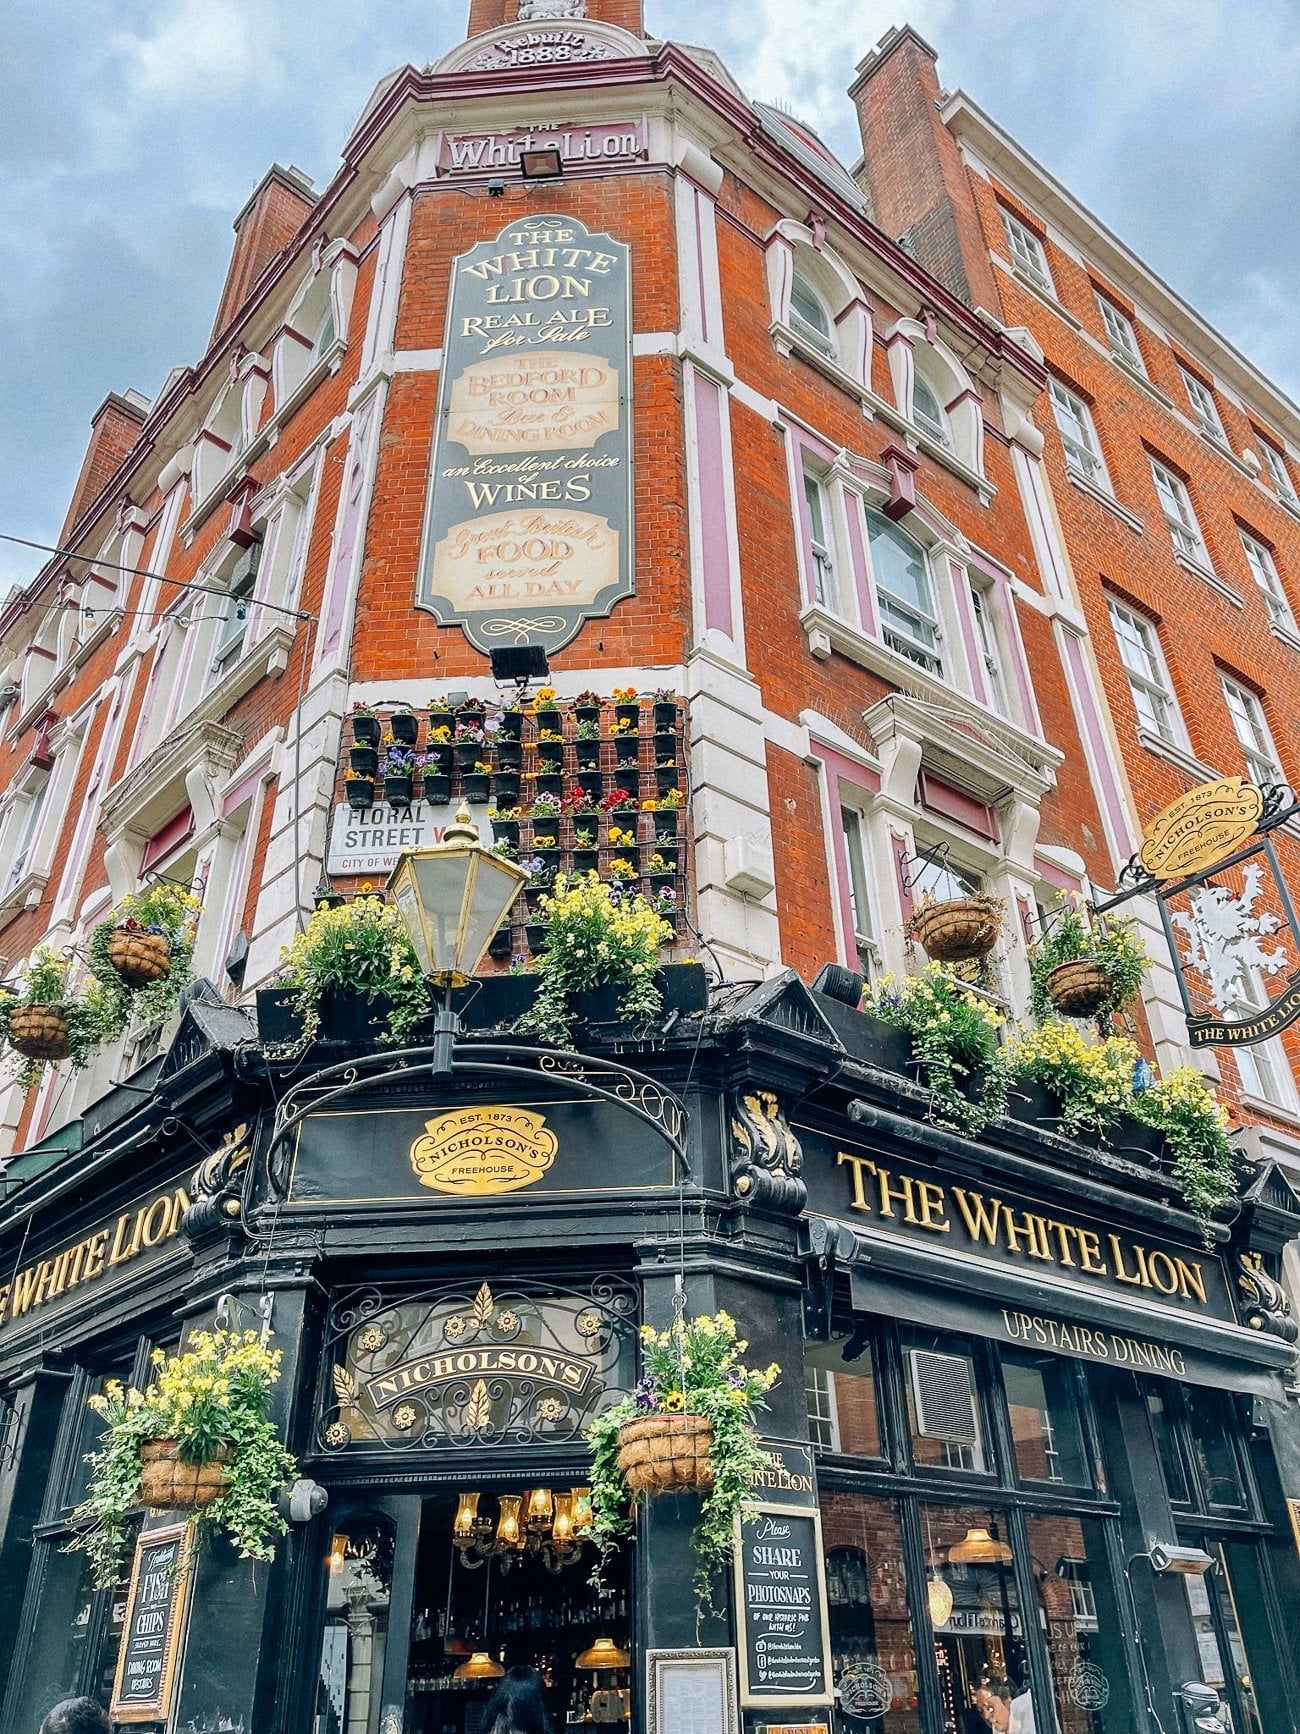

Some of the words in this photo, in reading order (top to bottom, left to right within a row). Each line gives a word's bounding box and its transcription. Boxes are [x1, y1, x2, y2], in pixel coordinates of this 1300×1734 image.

[494, 30, 585, 53] Rebuilt
[510, 46, 571, 65] 1888
[528, 123, 560, 133] THE
[562, 131, 640, 161] Lion
[508, 228, 575, 246] THE
[460, 248, 619, 281] WHITE
[486, 274, 592, 305] LION
[461, 312, 541, 338] REAL
[547, 307, 613, 328] ALE
[479, 331, 525, 355] for
[528, 325, 590, 345] Sale
[514, 357, 559, 370] THE
[468, 367, 608, 397] BEDFORD
[488, 387, 579, 408] ROOM
[458, 419, 540, 443] DINING
[544, 410, 610, 441] ROOM
[441, 464, 470, 478] an
[473, 455, 565, 476] Excellent
[564, 453, 620, 471] choice
[518, 472, 539, 485] of
[464, 473, 592, 509] WINES
[477, 538, 575, 564] FOOD
[484, 561, 562, 581] served
[465, 582, 521, 600] ALL
[525, 579, 584, 597] DAY
[1190, 789, 1214, 803] 1873
[347, 806, 426, 827] FLORAL
[345, 827, 425, 848] STREET
[1156, 805, 1248, 860] NICHOLSON'S
[1177, 828, 1231, 861] FREEHOUSE
[342, 859, 363, 868] CITY
[367, 858, 380, 867] OF
[1194, 1027, 1225, 1042] THE
[1226, 1014, 1280, 1041] WHITE
[1277, 990, 1300, 1018] LIO
[459, 1113, 483, 1125] EST.
[487, 1113, 513, 1123] 1873
[428, 1136, 539, 1165] NICHOLSON'S
[451, 1165, 514, 1175] FREEHOUSE
[836, 1151, 951, 1234] THE
[951, 1186, 1108, 1276] WHITE
[1107, 1232, 1208, 1304] LION
[12, 1228, 110, 1317] WHITE
[1000, 1308, 1109, 1359] UPSTAIRS
[1109, 1335, 1187, 1376] DINING
[376, 1350, 584, 1401] NICHOLSON'S
[777, 1471, 813, 1493] LION
[756, 1517, 791, 1540] Please
[753, 1545, 802, 1567] SHARE
[769, 1571, 790, 1581] YOUR
[747, 1583, 811, 1604] PHOTOSNAPS
[136, 1611, 165, 1635] CHIPS
[145, 1658, 162, 1674] ROOM
